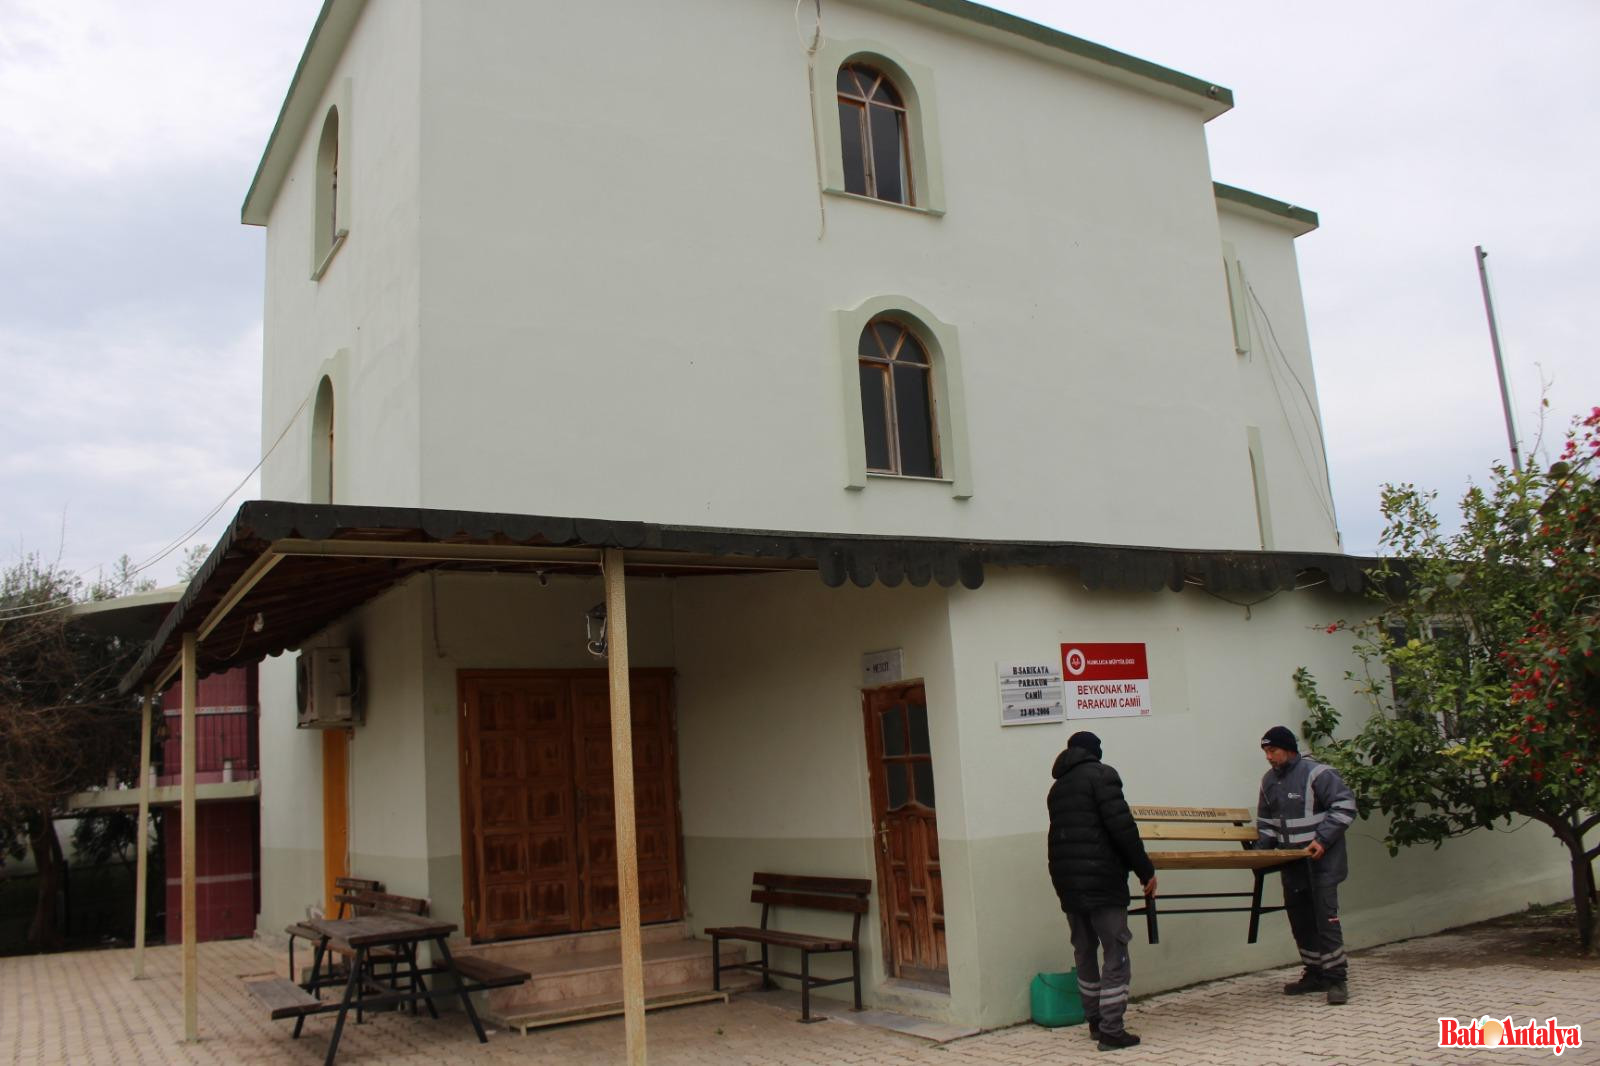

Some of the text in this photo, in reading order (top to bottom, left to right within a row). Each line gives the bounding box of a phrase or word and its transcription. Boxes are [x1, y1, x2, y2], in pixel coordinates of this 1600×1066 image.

[1018, 678, 1048, 688] PARAKUM
[1077, 683, 1139, 695] BEYKONAK MH.
[1077, 695, 1141, 709] PARAKUM CAMİİ
